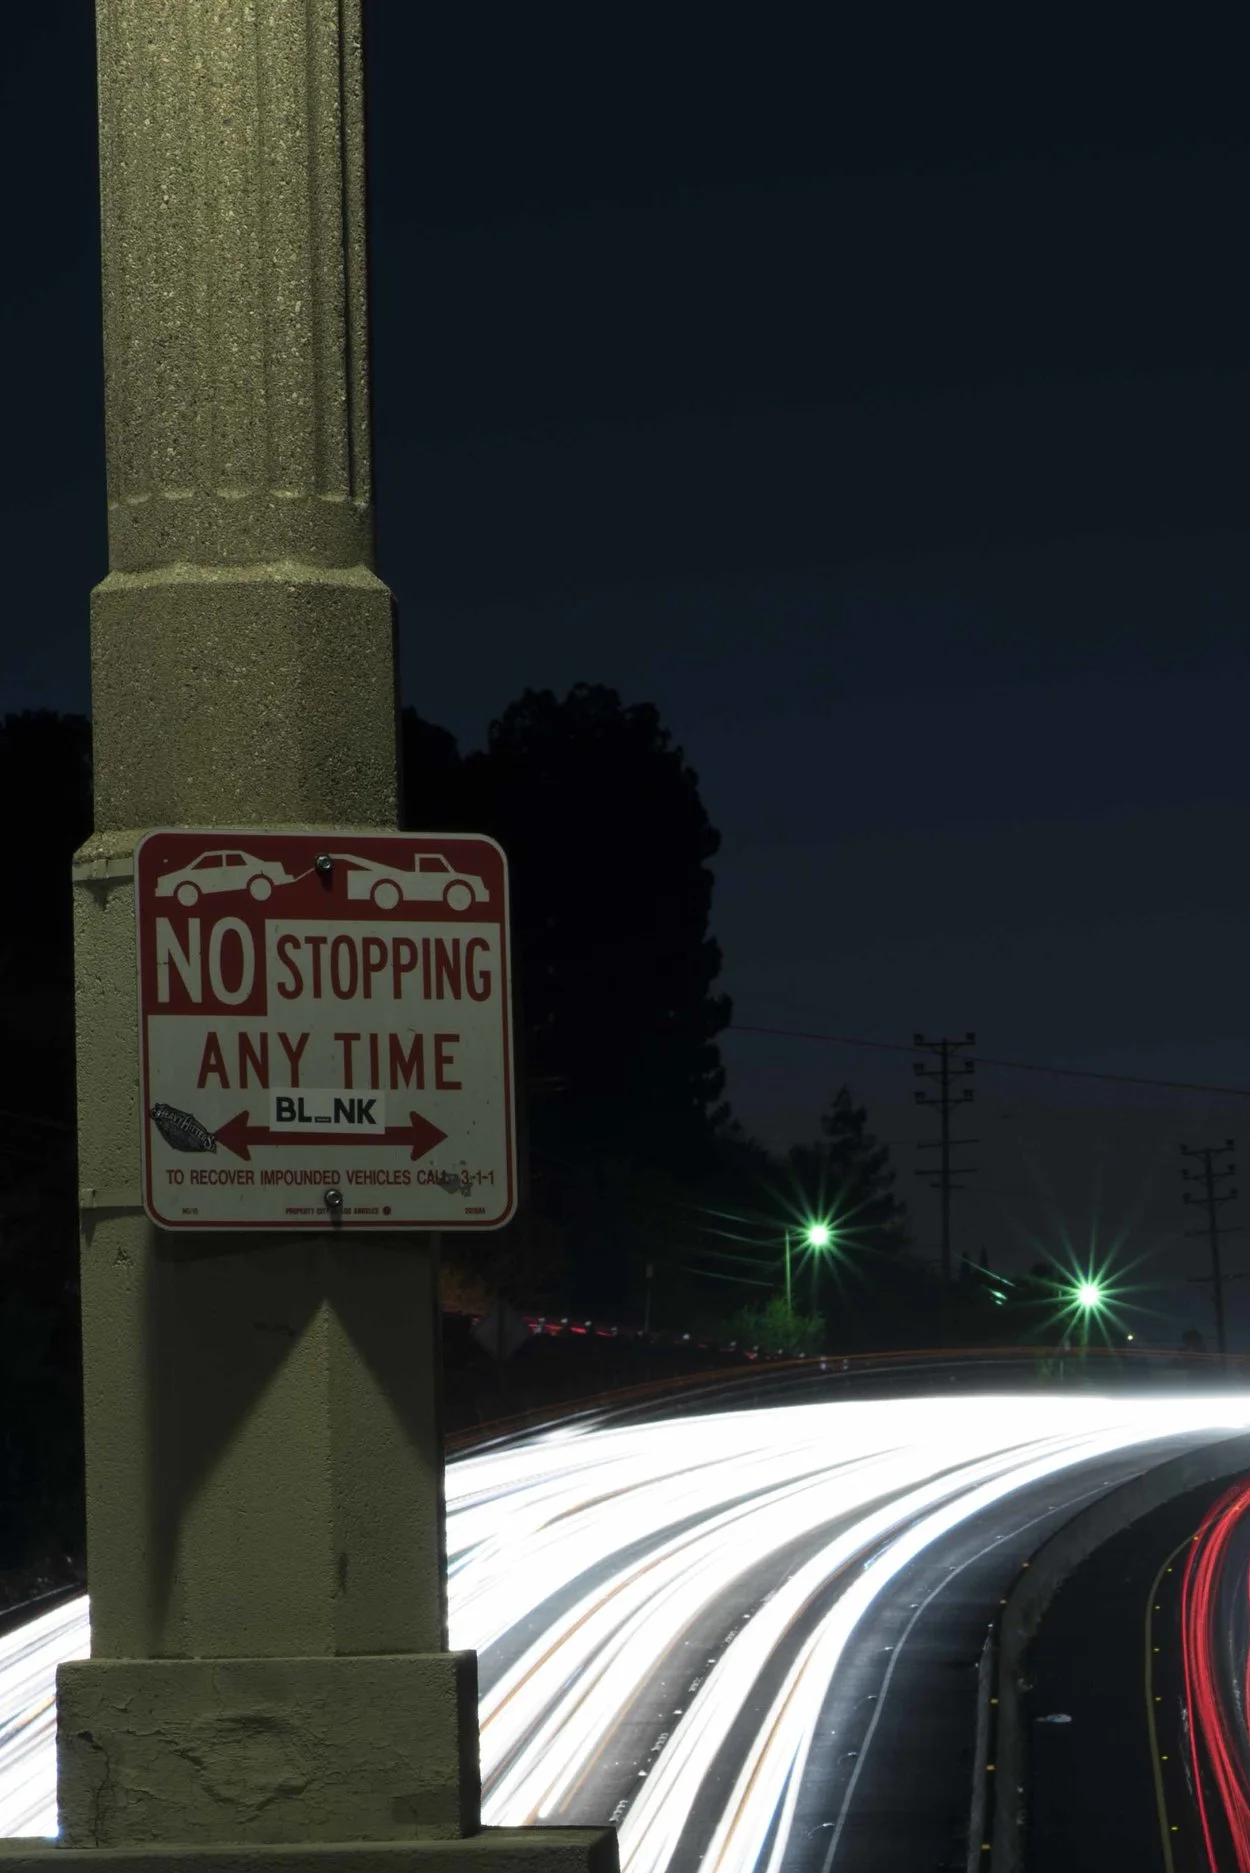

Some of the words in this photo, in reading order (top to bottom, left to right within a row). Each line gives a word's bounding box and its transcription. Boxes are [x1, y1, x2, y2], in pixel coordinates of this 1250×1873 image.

[156, 917, 255, 1005] NO
[277, 934, 492, 1002] STOPPING
[197, 1031, 311, 1089] ANY
[334, 1032, 463, 1090] TIME
[275, 1096, 377, 1125] BL_NK
[166, 1169, 184, 1185] TO
[190, 1169, 255, 1185] RECOVER
[260, 1170, 340, 1185] IMPOUNDED
[346, 1170, 411, 1185] VEHICLES
